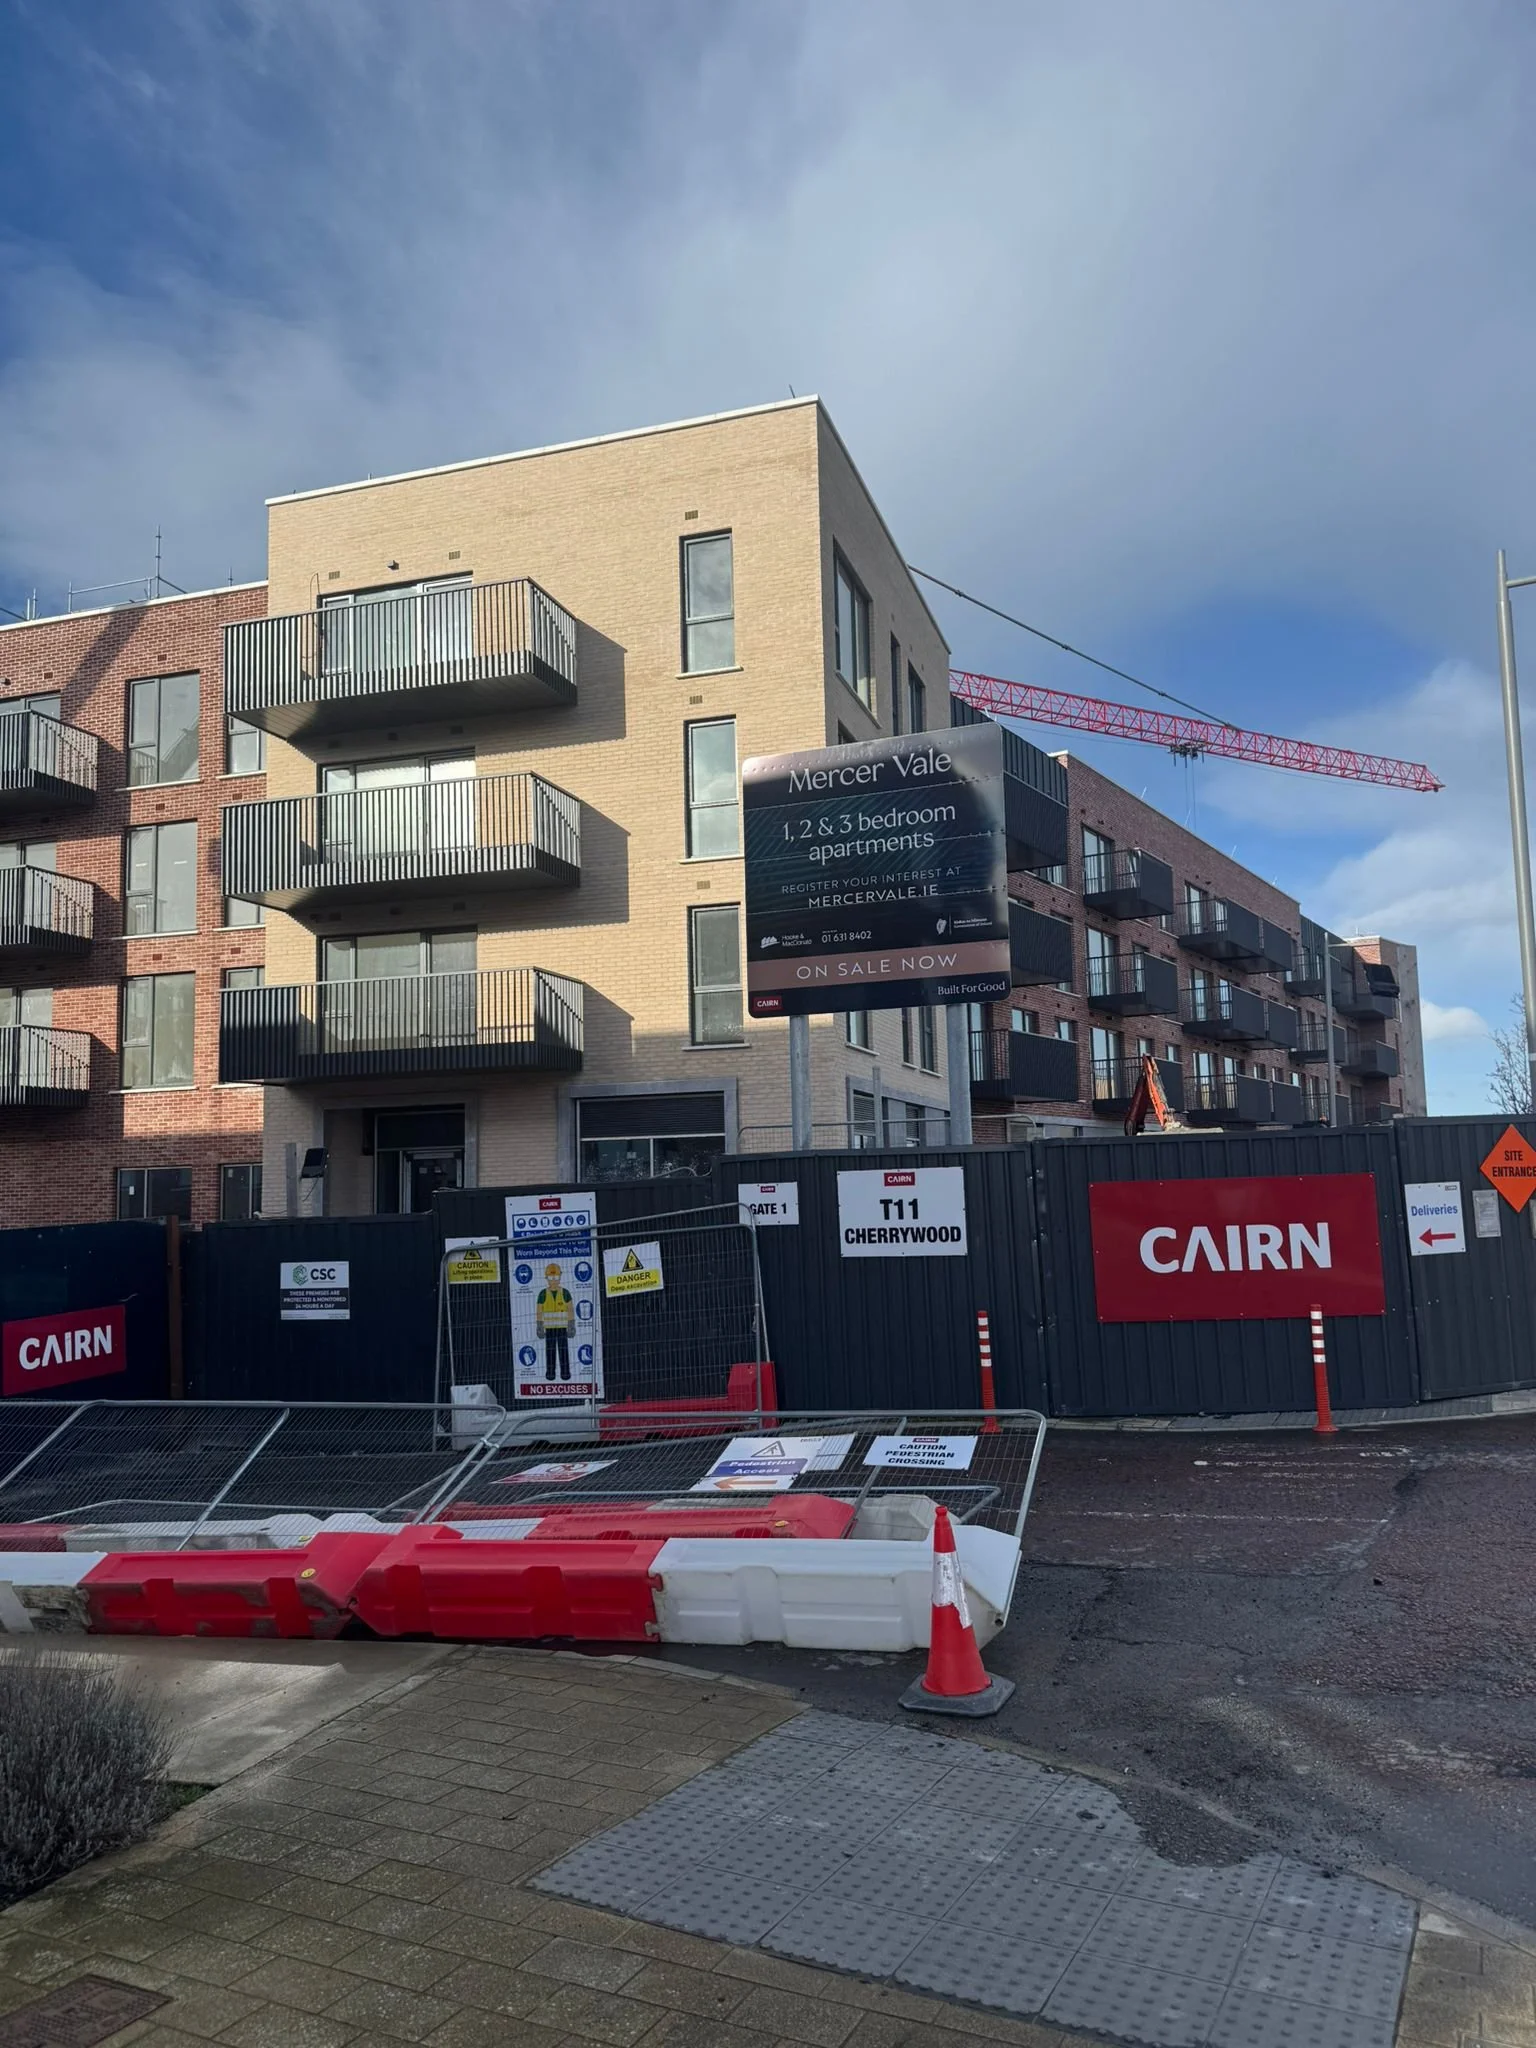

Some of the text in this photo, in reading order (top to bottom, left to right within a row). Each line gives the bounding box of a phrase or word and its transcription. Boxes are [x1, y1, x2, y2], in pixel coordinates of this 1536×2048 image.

[788, 748, 952, 793] Mercer Vale
[800, 820, 812, 839] 2
[818, 817, 834, 837] &
[839, 814, 852, 834] 3
[858, 804, 956, 832] bedroom
[808, 830, 935, 865] apartments
[781, 866, 961, 895] REGISTER YOUR INTEREST AT
[808, 884, 939, 909] MERCERVALE.IE
[821, 930, 872, 943] 01 631 8402
[796, 953, 958, 980] ON SALE NOW
[937, 981, 1005, 995] Built For Good
[757, 1000, 779, 1008] CAIRN
[1504, 1150, 1523, 1161] SITE
[1492, 1166, 1536, 1177] ENTRANCE
[887, 1175, 912, 1184] CAIRN
[750, 1202, 787, 1215] GATE 1
[879, 1199, 920, 1221] T11
[1411, 1203, 1458, 1217] Deliveries
[844, 1225, 962, 1245] CHERRYWOOD
[534, 1247, 558, 1256] Beyond
[559, 1246, 572, 1254] This
[1139, 1222, 1333, 1274] CAIRN
[457, 1261, 489, 1269] CAUTION
[310, 1268, 336, 1280] CSC
[616, 1272, 651, 1284] DANGER
[18, 1325, 112, 1370] CAIRN
[530, 1384, 588, 1394] NO EXCUSES
[729, 1460, 796, 1468] Pedestrian
[888, 1457, 945, 1466] CROSSING
